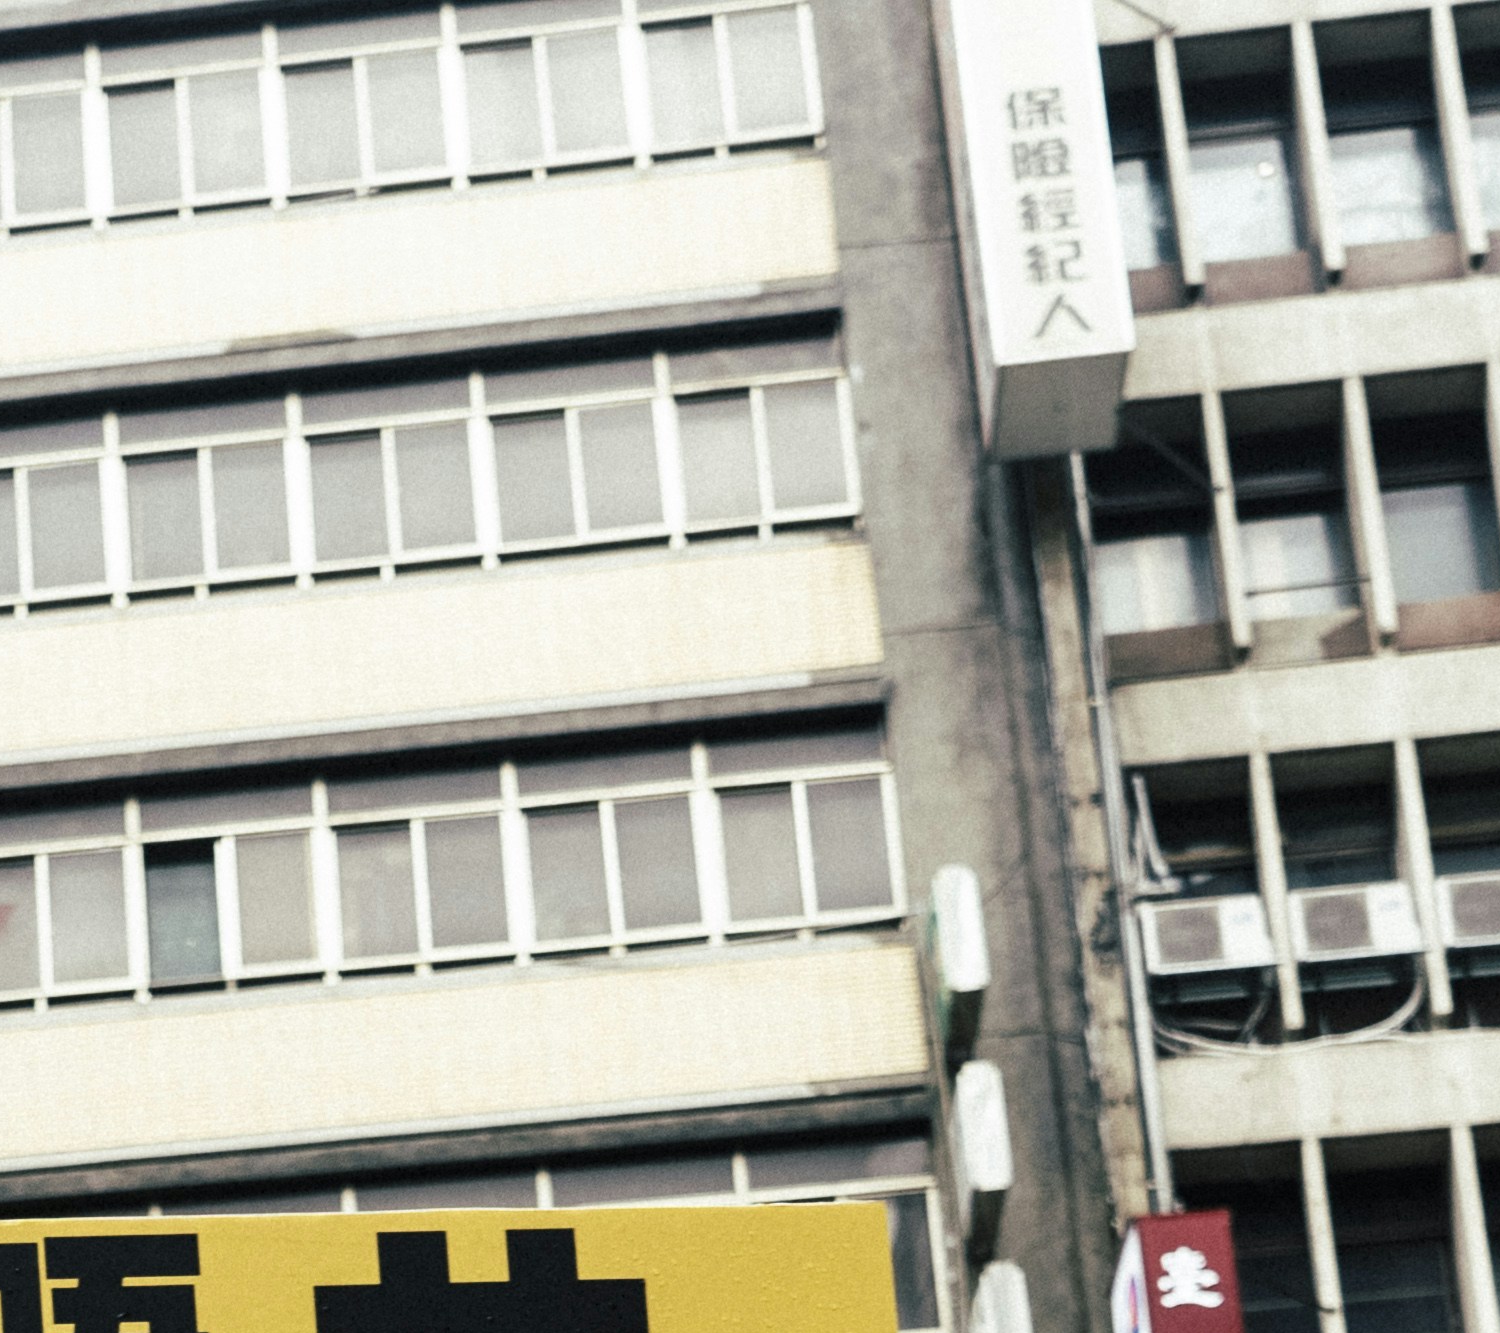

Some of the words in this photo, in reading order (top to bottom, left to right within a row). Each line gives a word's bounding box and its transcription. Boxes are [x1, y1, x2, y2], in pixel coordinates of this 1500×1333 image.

[1007, 86, 1092, 338] 保險經紀人
